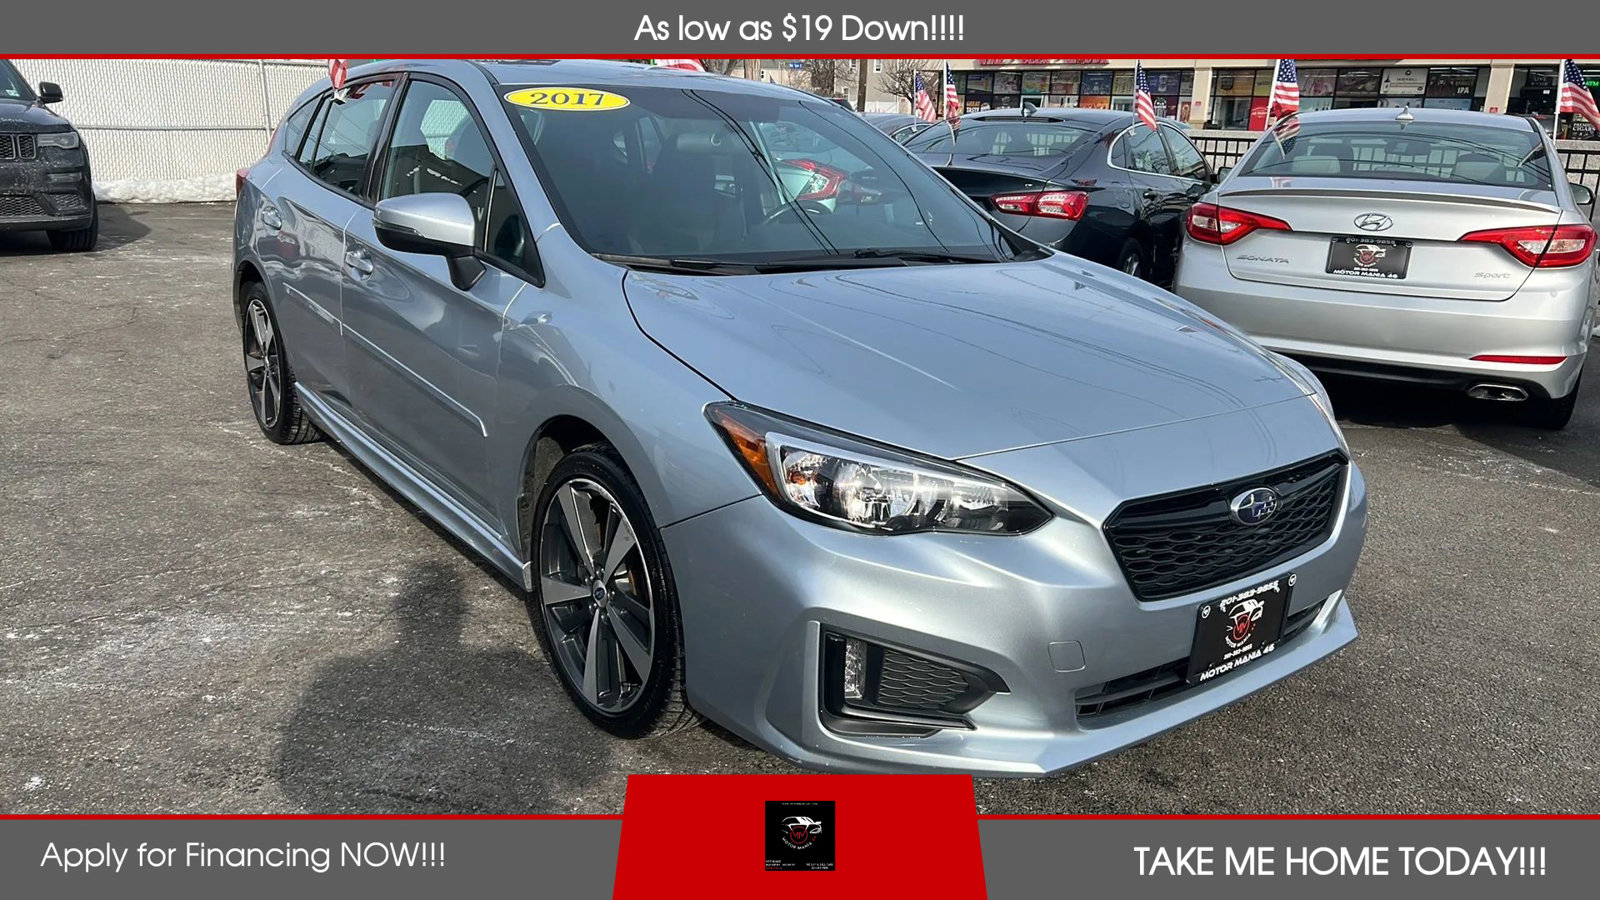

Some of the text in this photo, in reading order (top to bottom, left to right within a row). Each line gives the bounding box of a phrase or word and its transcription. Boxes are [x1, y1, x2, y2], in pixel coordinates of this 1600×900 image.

[530, 92, 604, 106] 2017
[1236, 254, 1290, 264] SONATA
[1200, 643, 1275, 682] MOTOR MANIA 46
